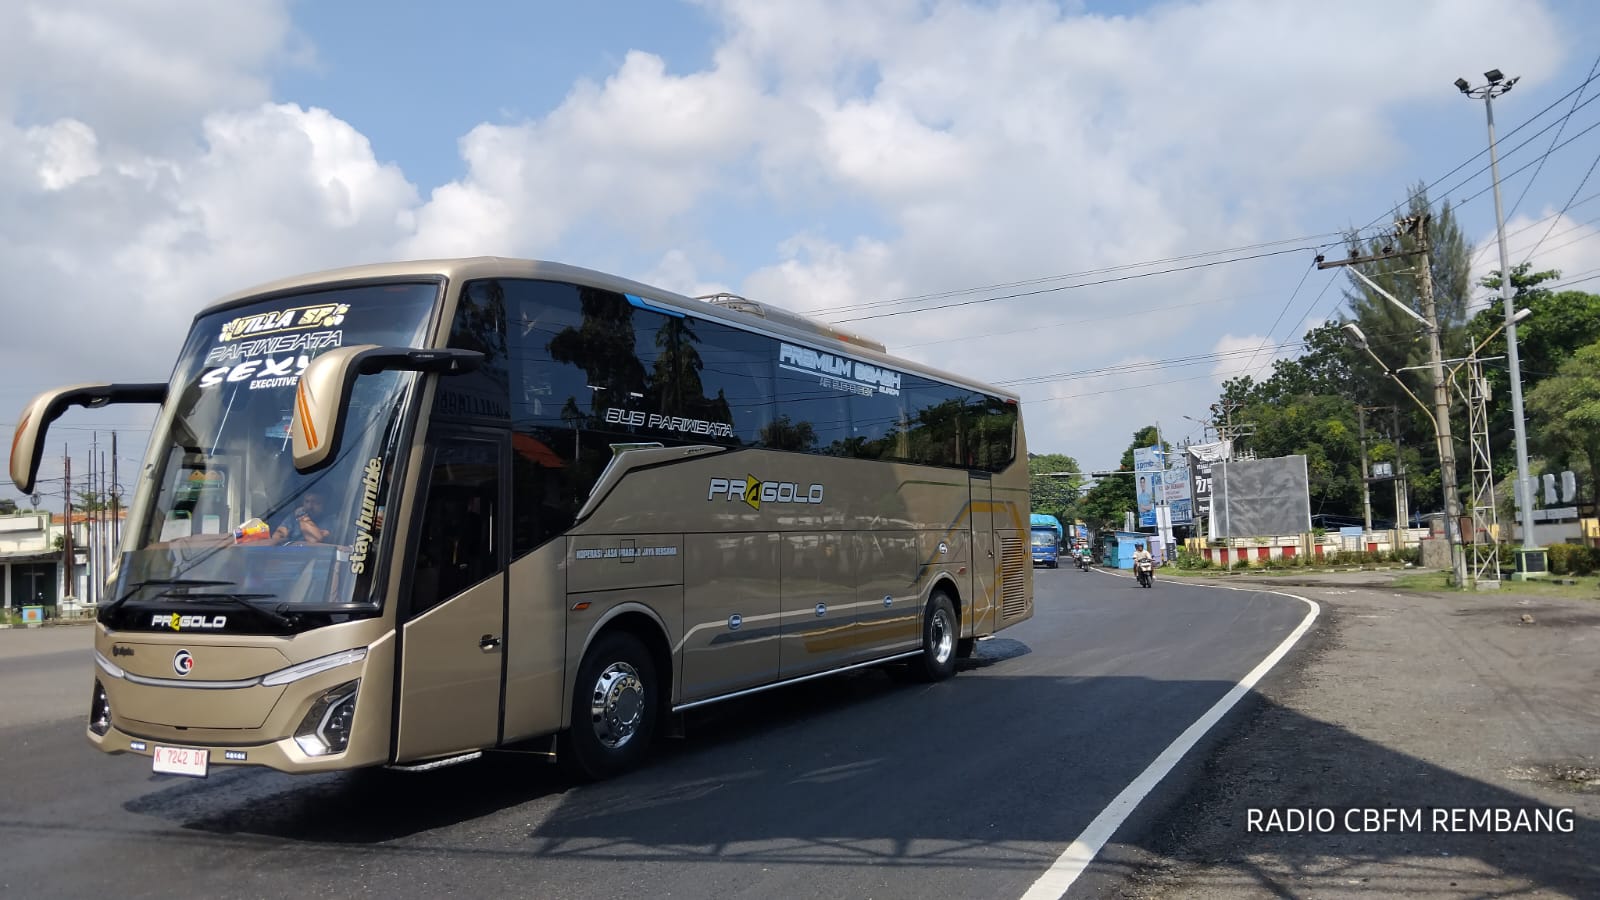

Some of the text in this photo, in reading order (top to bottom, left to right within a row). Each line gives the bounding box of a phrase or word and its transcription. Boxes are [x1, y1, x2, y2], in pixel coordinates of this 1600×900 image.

[232, 310, 296, 337] VILLA
[203, 330, 342, 365] PARIWISATA
[249, 376, 298, 390] EXECUTIVE
[605, 408, 734, 438] BUS PARIWISATA
[349, 529, 374, 575] stay
[155, 748, 161, 762] K
[167, 750, 188, 765] 7242
